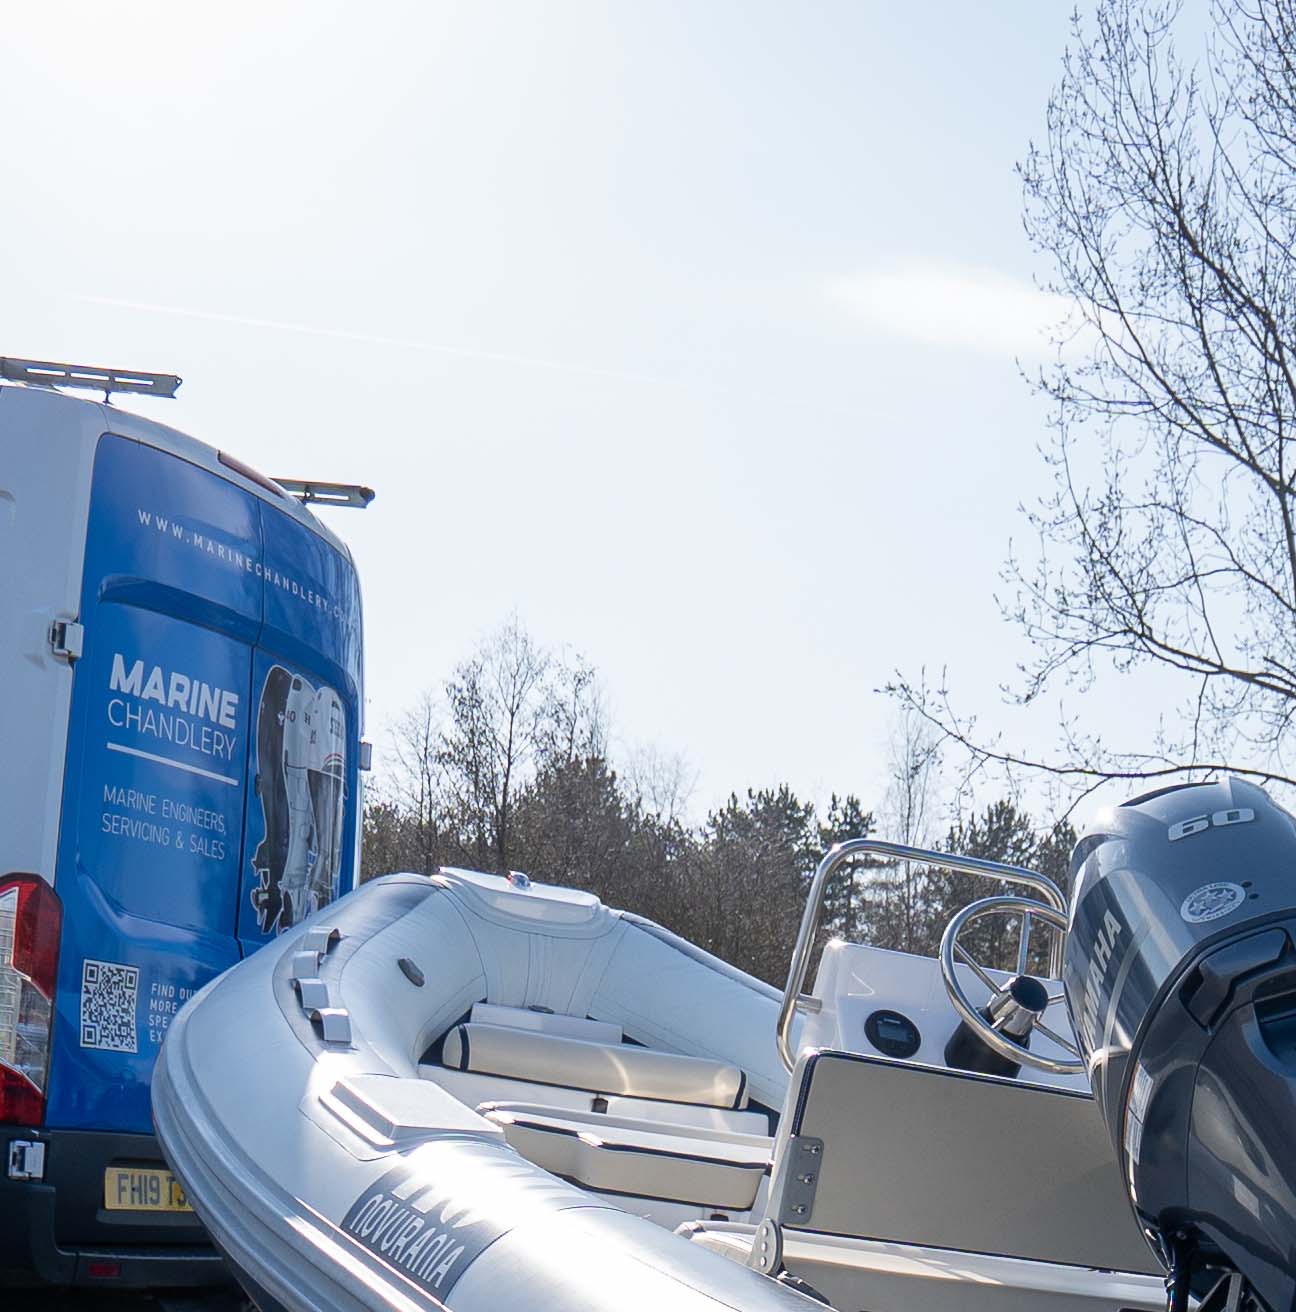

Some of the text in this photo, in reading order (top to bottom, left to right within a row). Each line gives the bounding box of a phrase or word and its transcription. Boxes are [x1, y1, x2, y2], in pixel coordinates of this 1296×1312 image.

[109, 652, 239, 729] MARINE
[107, 699, 237, 760] CHANDLERY
[103, 784, 156, 815] MARINE
[102, 813, 225, 860] SERVICING & SALES
[1168, 807, 1256, 841] 60
[150, 998, 177, 1014] MORE
[151, 983, 175, 998] FIND
[149, 1014, 168, 1029] SPE
[117, 1173, 161, 1206] FH19
